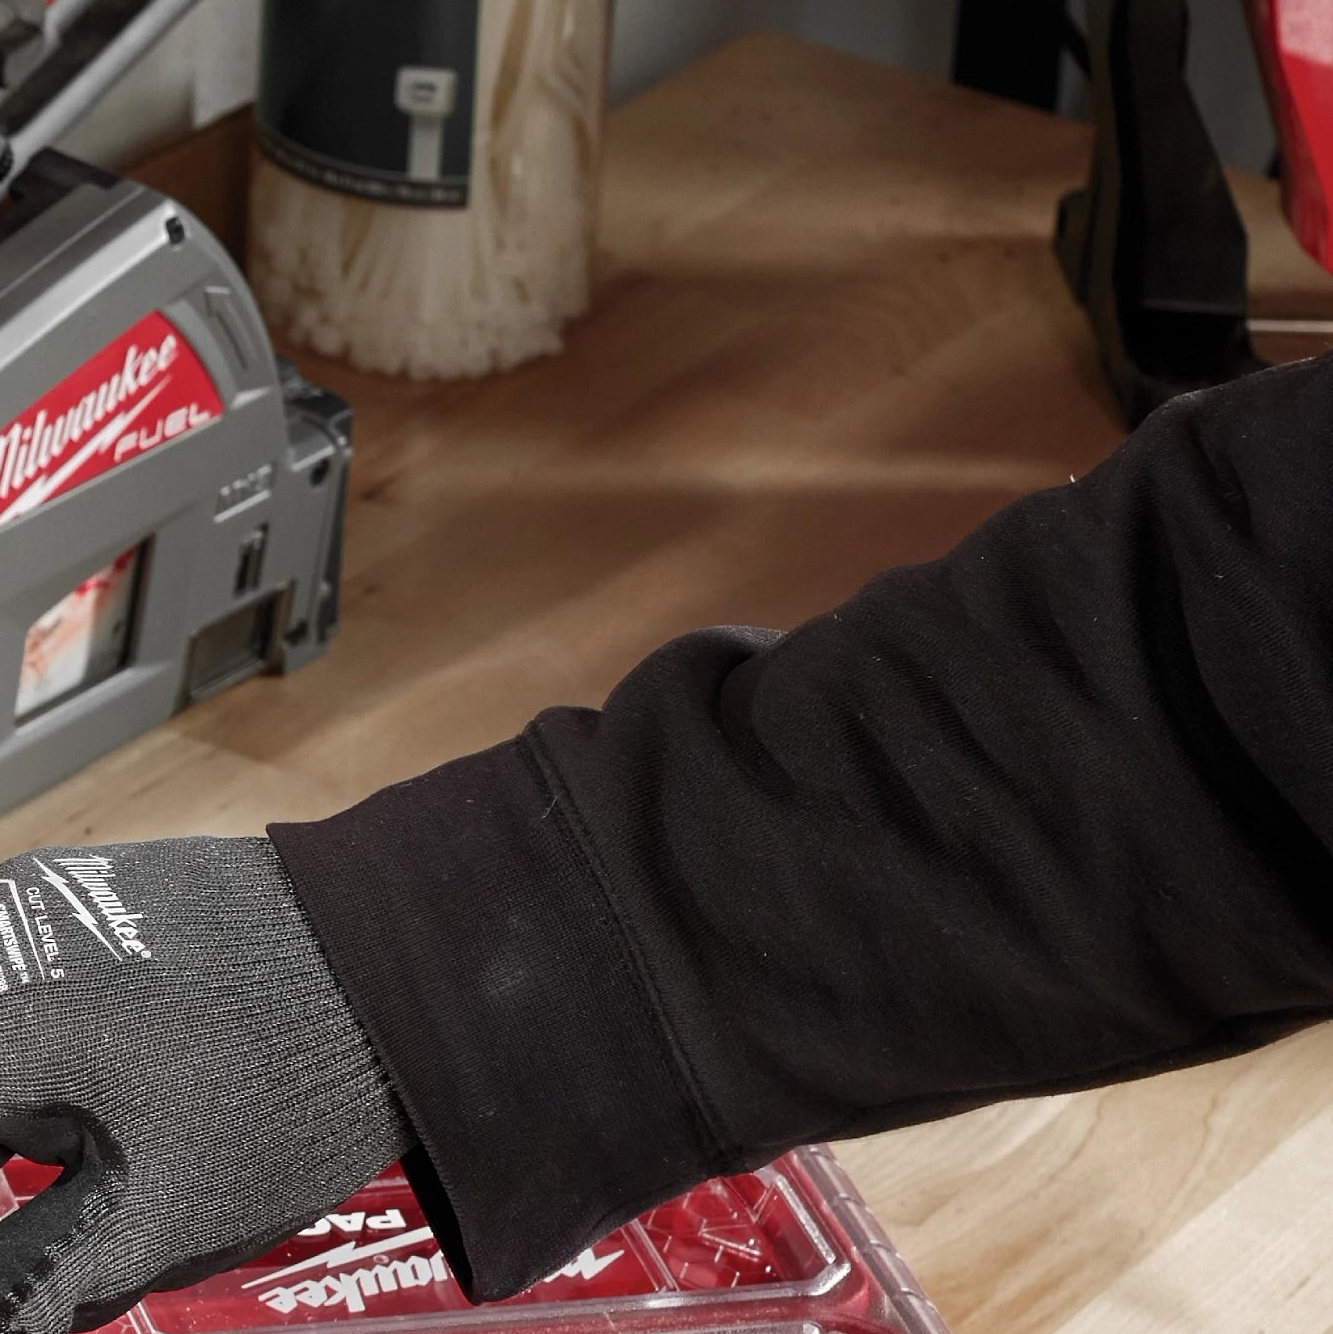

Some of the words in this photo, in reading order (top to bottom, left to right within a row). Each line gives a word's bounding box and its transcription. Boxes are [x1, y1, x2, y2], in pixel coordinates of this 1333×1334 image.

[113, 403, 211, 463] FUEL
[26, 887, 45, 911] CUT
[34, 916, 60, 963] LEVEL
[50, 968, 65, 979] 5
